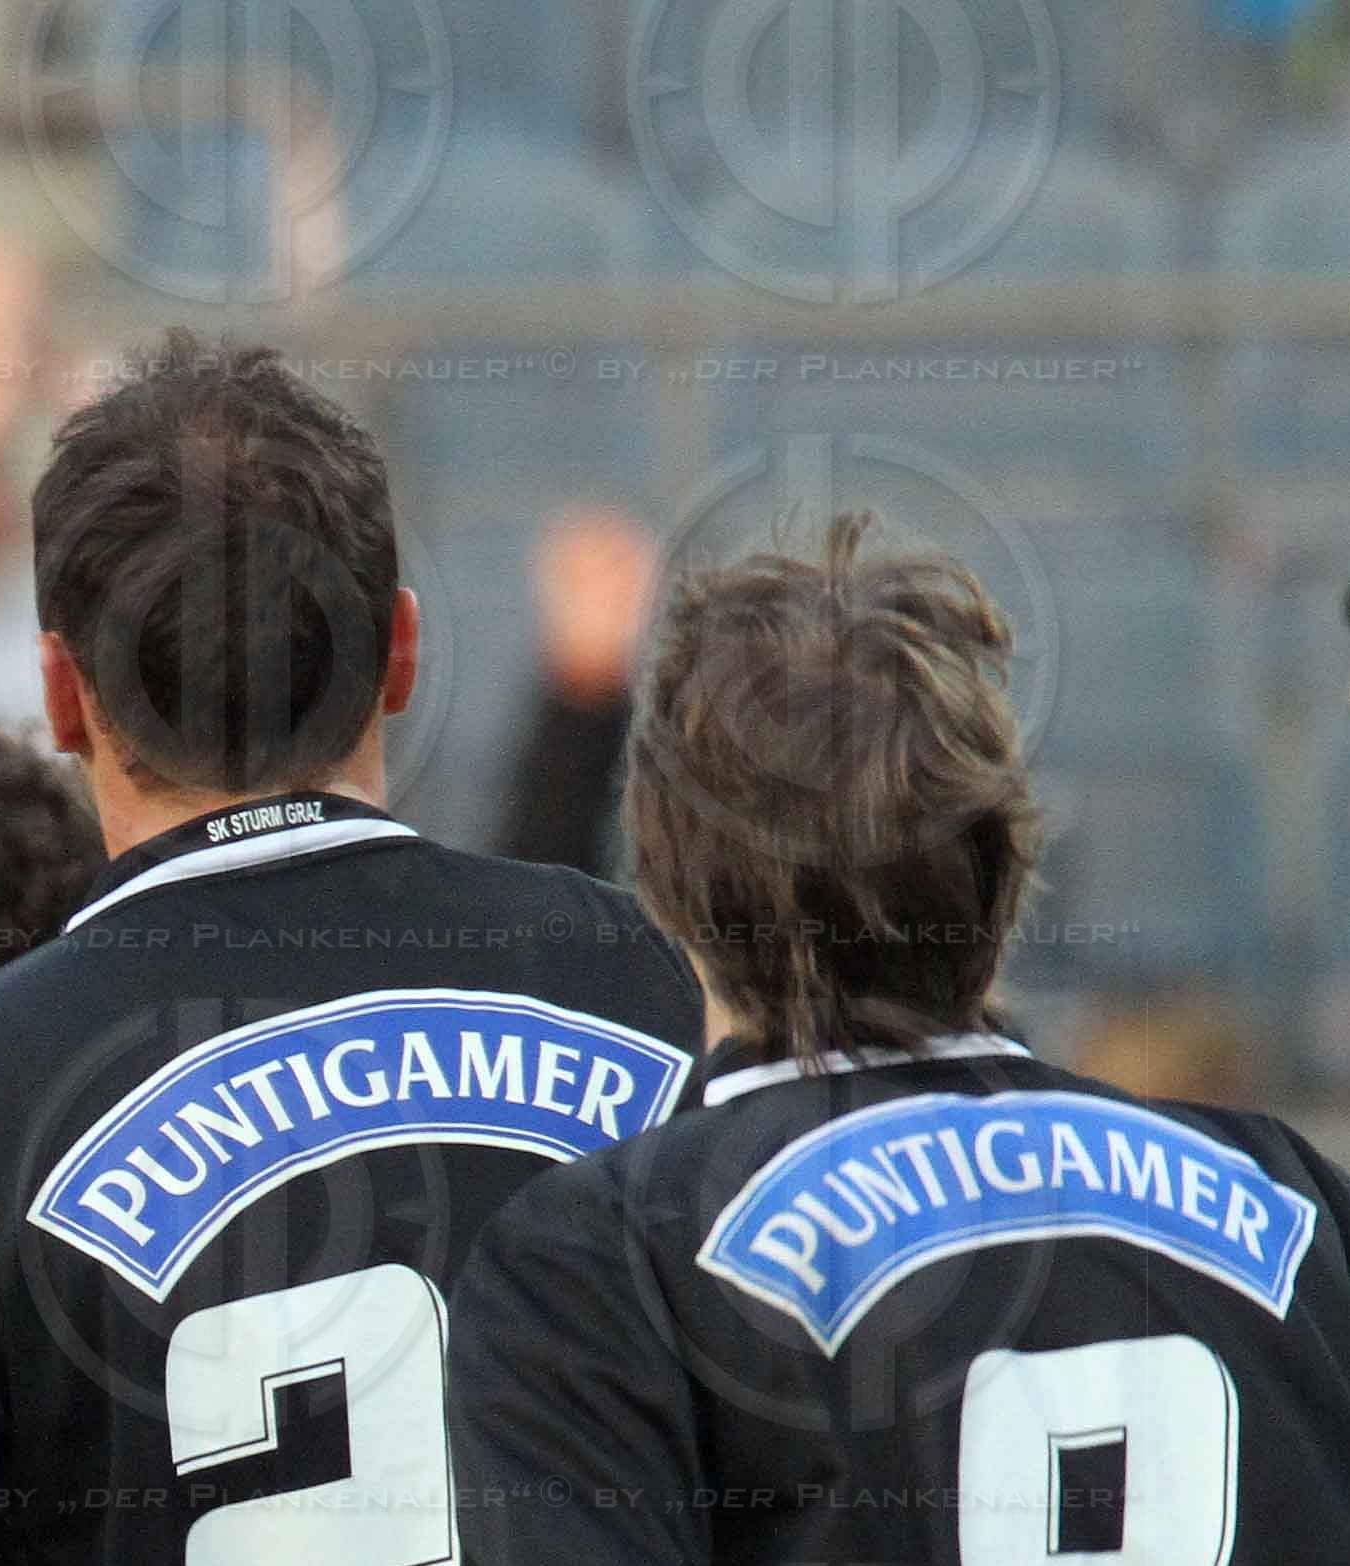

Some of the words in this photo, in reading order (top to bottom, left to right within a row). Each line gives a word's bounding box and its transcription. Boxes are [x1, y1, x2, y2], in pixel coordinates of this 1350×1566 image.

[206, 817, 231, 842] SK
[229, 804, 285, 836] STURM
[285, 800, 326, 825] GRAZ
[78, 1029, 637, 1248] PUNTIGAMER
[750, 1118, 1271, 1297] PUNTIGAMER
